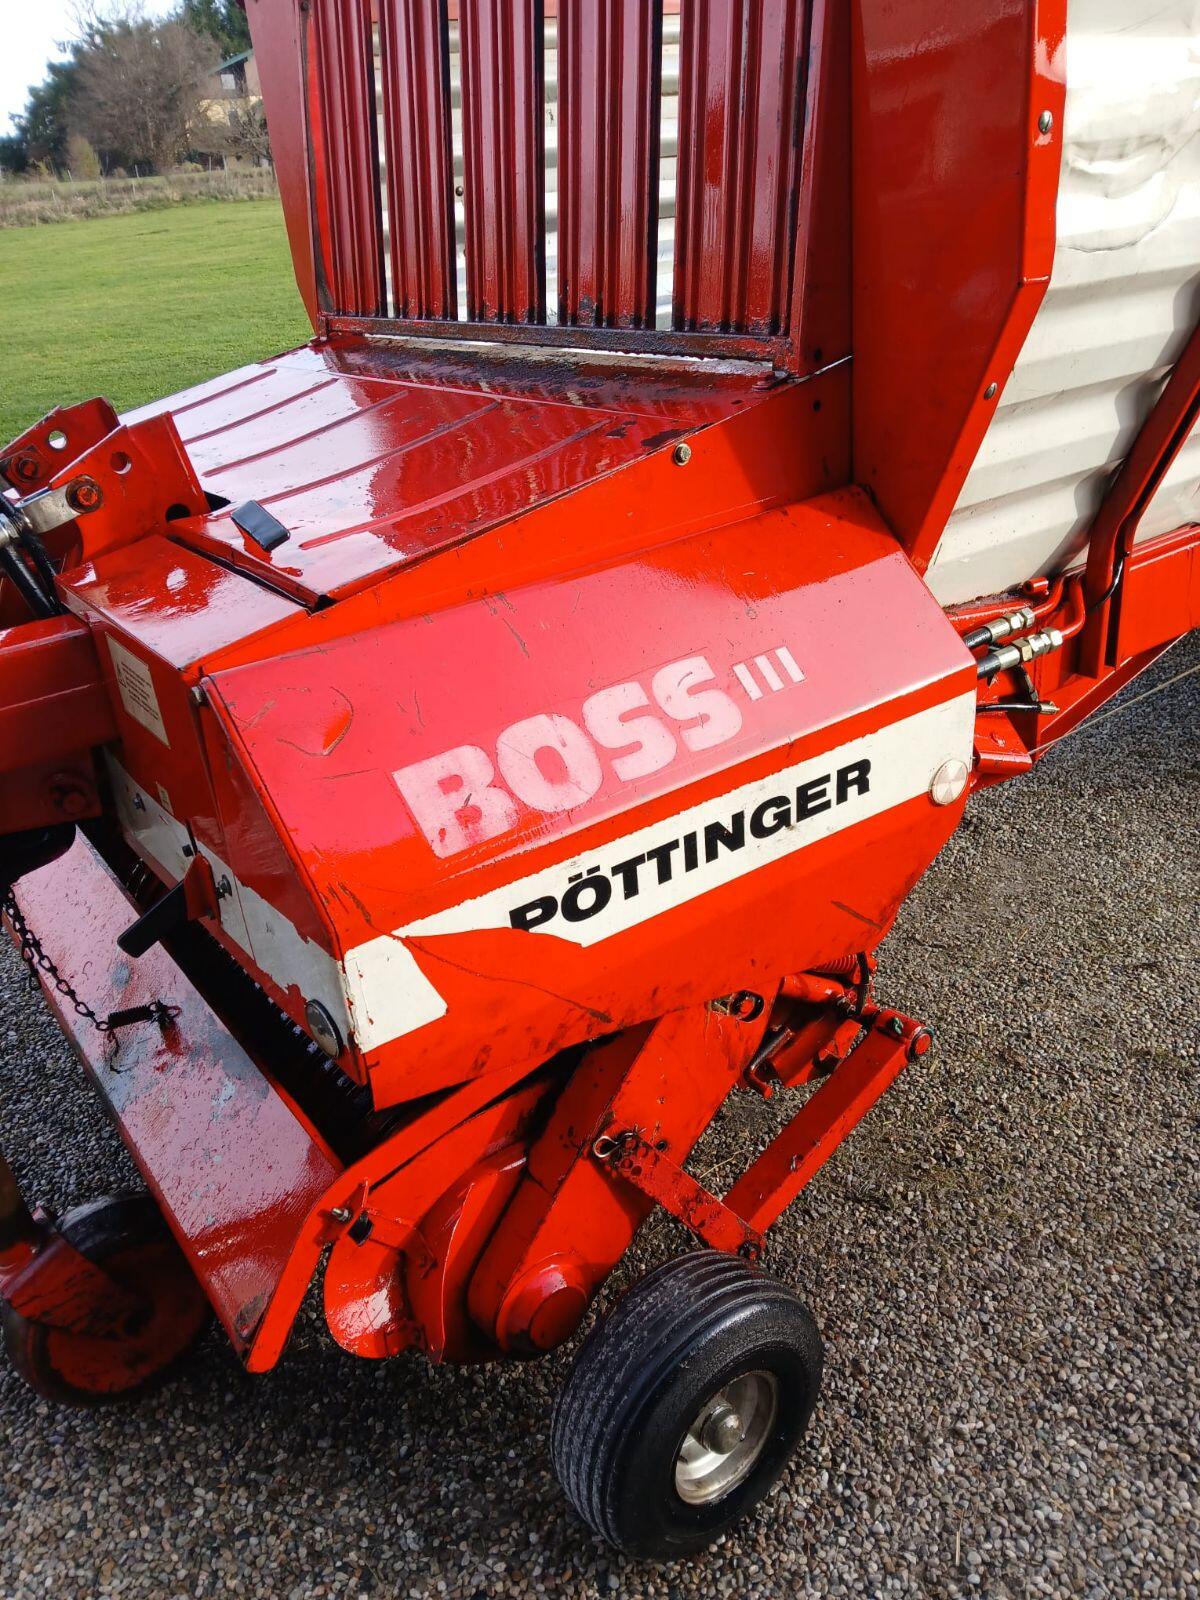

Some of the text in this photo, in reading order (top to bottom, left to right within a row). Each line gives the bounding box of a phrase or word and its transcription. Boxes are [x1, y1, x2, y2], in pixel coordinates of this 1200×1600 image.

[392, 647, 806, 859] BOSS III
[509, 758, 872, 931] PÖTTINGER
